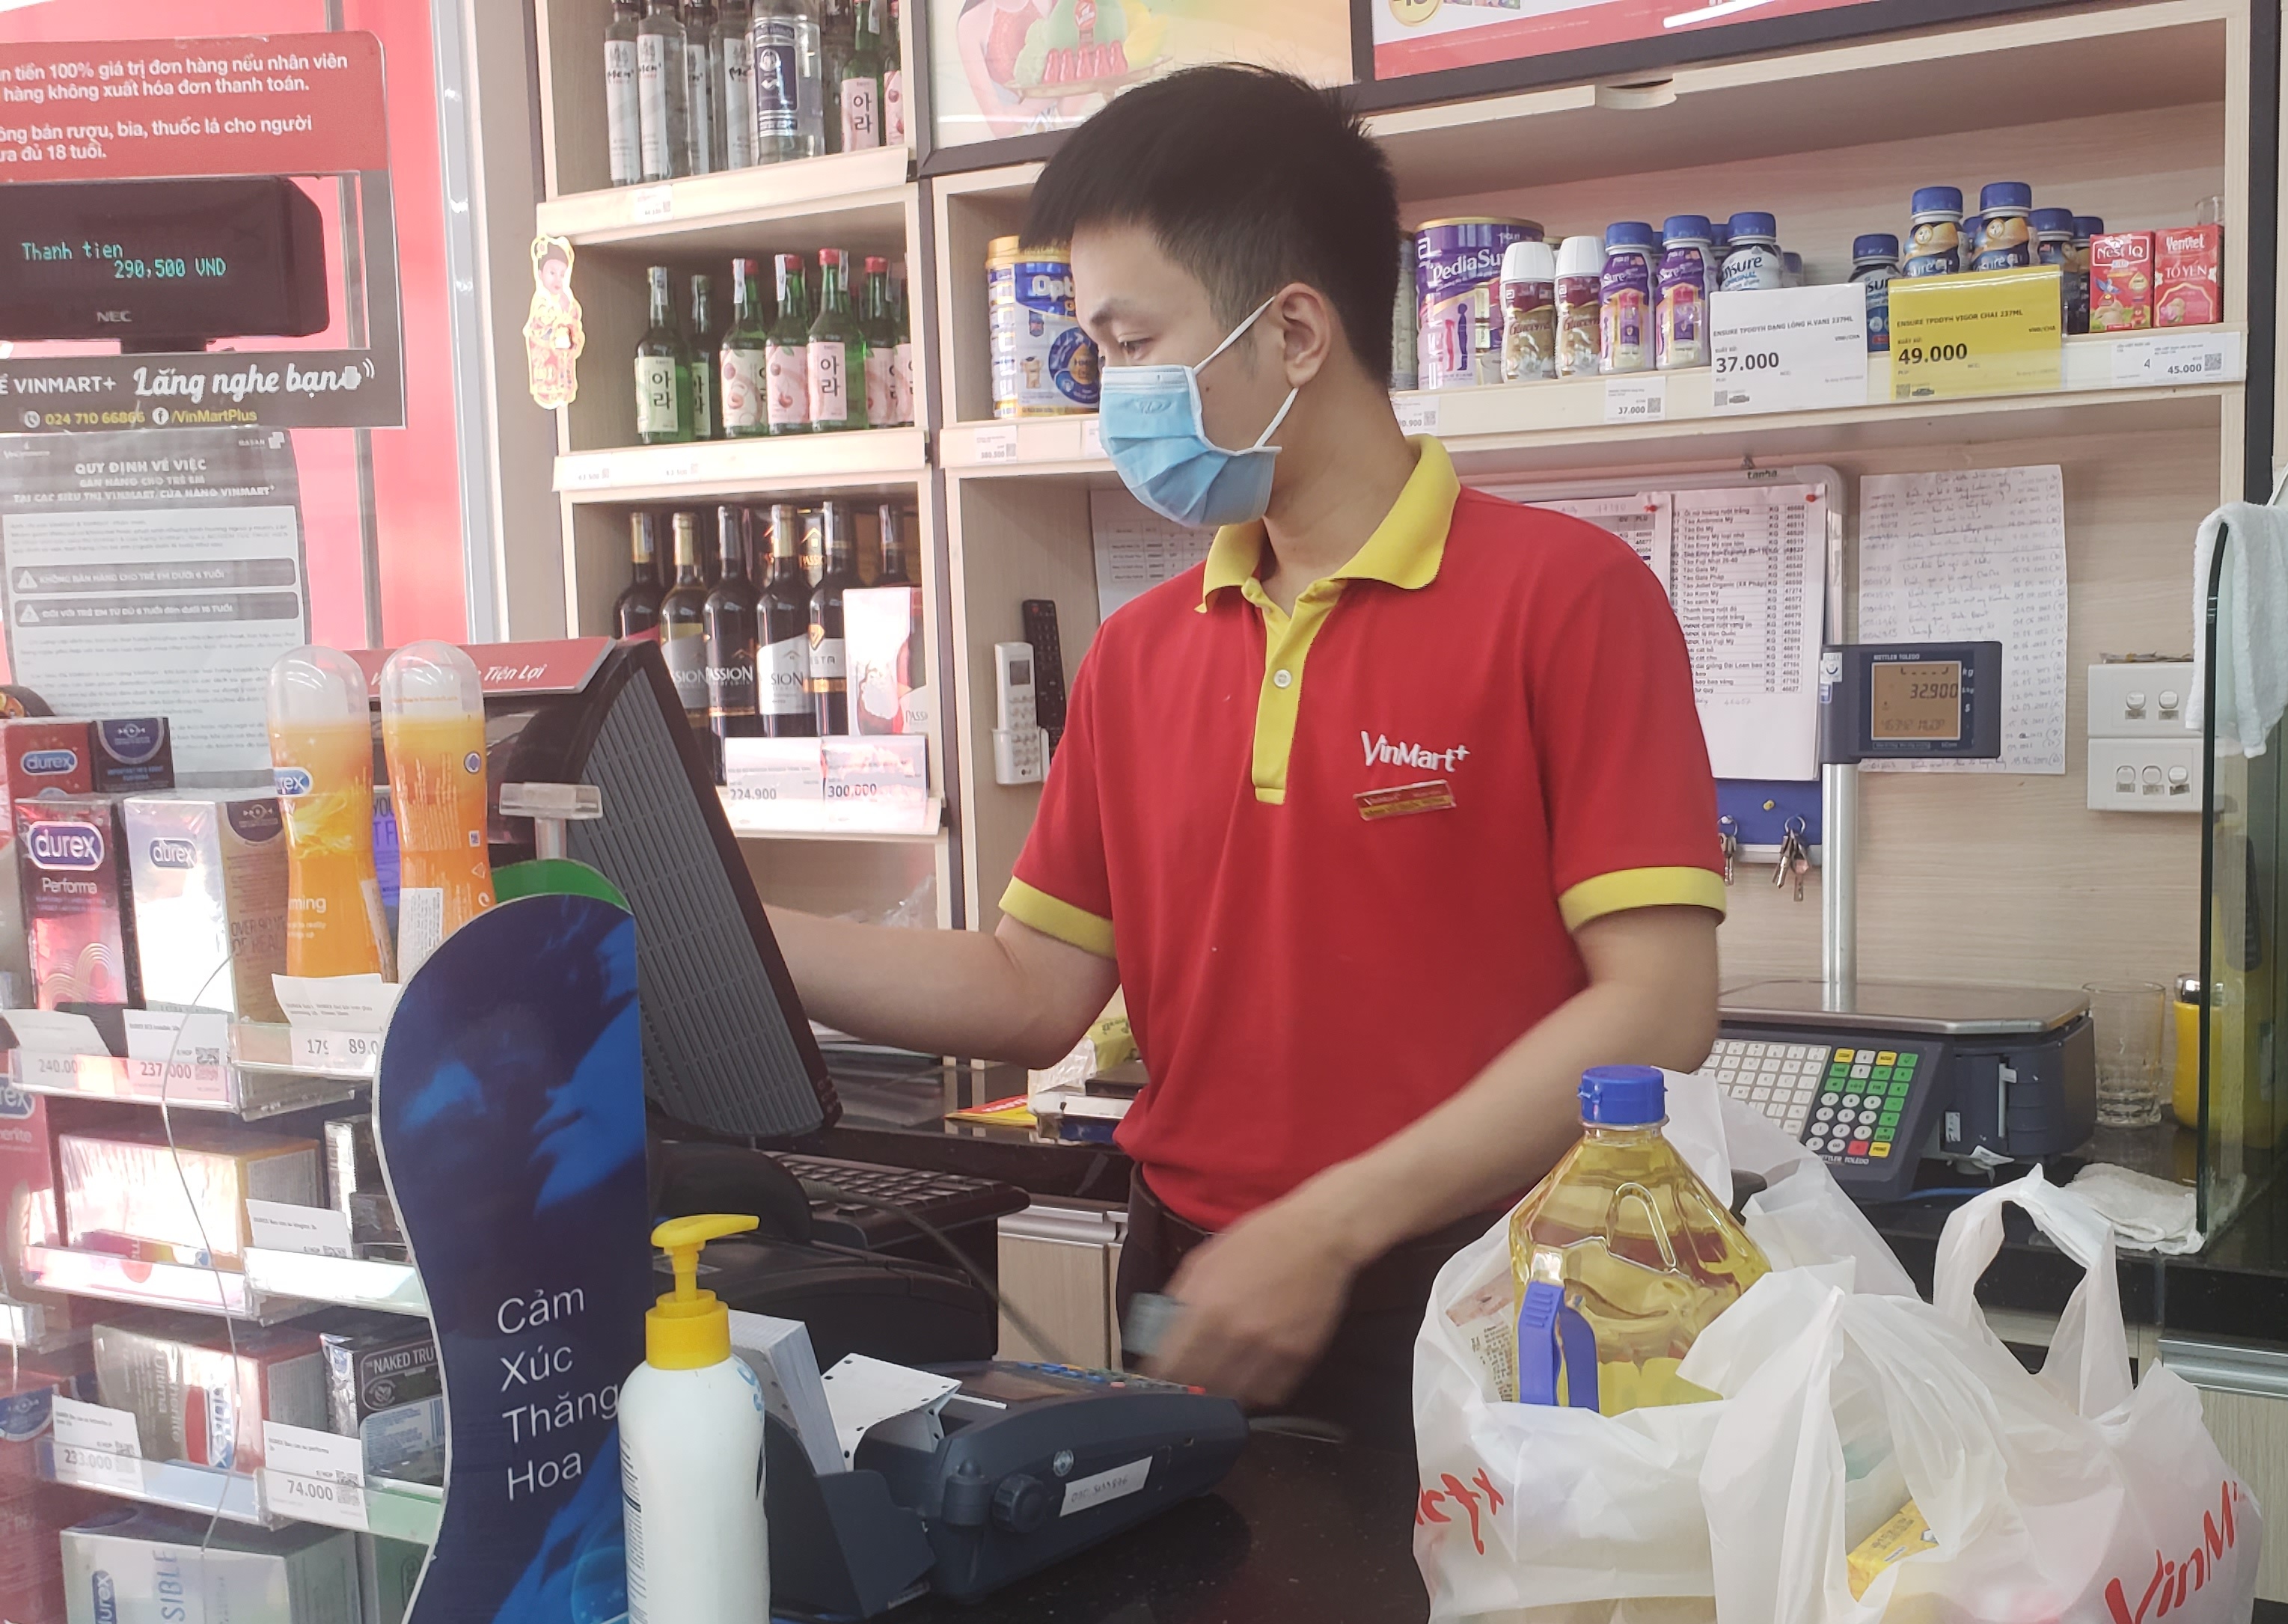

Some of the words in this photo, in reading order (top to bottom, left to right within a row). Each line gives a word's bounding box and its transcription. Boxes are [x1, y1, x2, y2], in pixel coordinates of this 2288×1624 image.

[15, 62, 45, 82] tiền
[49, 61, 94, 79] 100%
[98, 60, 124, 81] giá
[128, 59, 146, 79] trị
[150, 59, 183, 76] đơn
[186, 58, 227, 76] hàng
[233, 52, 264, 73] nếu
[268, 54, 310, 72] nhân
[313, 52, 349, 70] viên
[4, 85, 44, 104] hàng
[48, 82, 100, 102] không
[103, 79, 139, 98] xuất
[143, 79, 174, 96] hóa
[177, 78, 212, 95] đơn
[215, 76, 263, 94] thanh
[266, 75, 311, 92] toán.
[31, 123, 64, 141] bán
[66, 125, 114, 141] rượu,
[117, 120, 149, 140] bia,
[152, 115, 201, 136] thuốc
[205, 117, 221, 135] lá
[224, 117, 257, 134] cho
[260, 114, 313, 136] người
[21, 143, 43, 161] đủ
[47, 144, 67, 160] 18
[70, 138, 107, 160] tuổi.
[22, 242, 73, 261] Thanh
[82, 240, 124, 259] tien
[114, 258, 186, 279] 290,500
[195, 257, 227, 277] VND
[1032, 274, 1075, 301] Opt
[97, 310, 133, 322] NEC
[1897, 318, 1924, 328] ENSURE
[1956, 313, 1978, 322] VIGOR
[1980, 310, 1998, 319] CHAI
[2000, 309, 2023, 318] 237ML
[1716, 352, 1780, 374] 37.000
[1898, 343, 1968, 365] 49.000
[820, 355, 840, 398] 아라
[2168, 363, 2203, 375] 45.000
[13, 376, 117, 395] VINMART+
[132, 366, 207, 404] Lắng
[212, 364, 281, 402] nghe
[285, 363, 346, 399] bạn
[652, 370, 672, 411] 아라
[45, 412, 72, 426] 024
[76, 412, 99, 425] 710
[171, 408, 258, 424] /VinMartPlus
[1618, 405, 1646, 414] 37.000
[75, 462, 105, 475] QUY
[108, 459, 148, 476] ĐỊNH
[173, 456, 207, 474] VIỆC
[484, 664, 515, 683] Tiện
[517, 663, 548, 684] Lợi
[26, 754, 74, 770] durex
[1360, 729, 1471, 773] VinMart+
[729, 787, 777, 801] 224.900
[828, 782, 877, 798] 300.000
[35, 828, 100, 863] durex
[153, 840, 195, 865] durex
[42, 877, 98, 895] Performa
[497, 1287, 585, 1335] Cảm
[373, 1348, 411, 1375] NAKED
[500, 1344, 573, 1392] Xúc
[501, 1383, 620, 1444] Thăng
[64, 1447, 113, 1471] 233.000
[507, 1451, 582, 1501] Hoa
[287, 1478, 334, 1501] 74.000
[97, 1573, 113, 1624] urex
